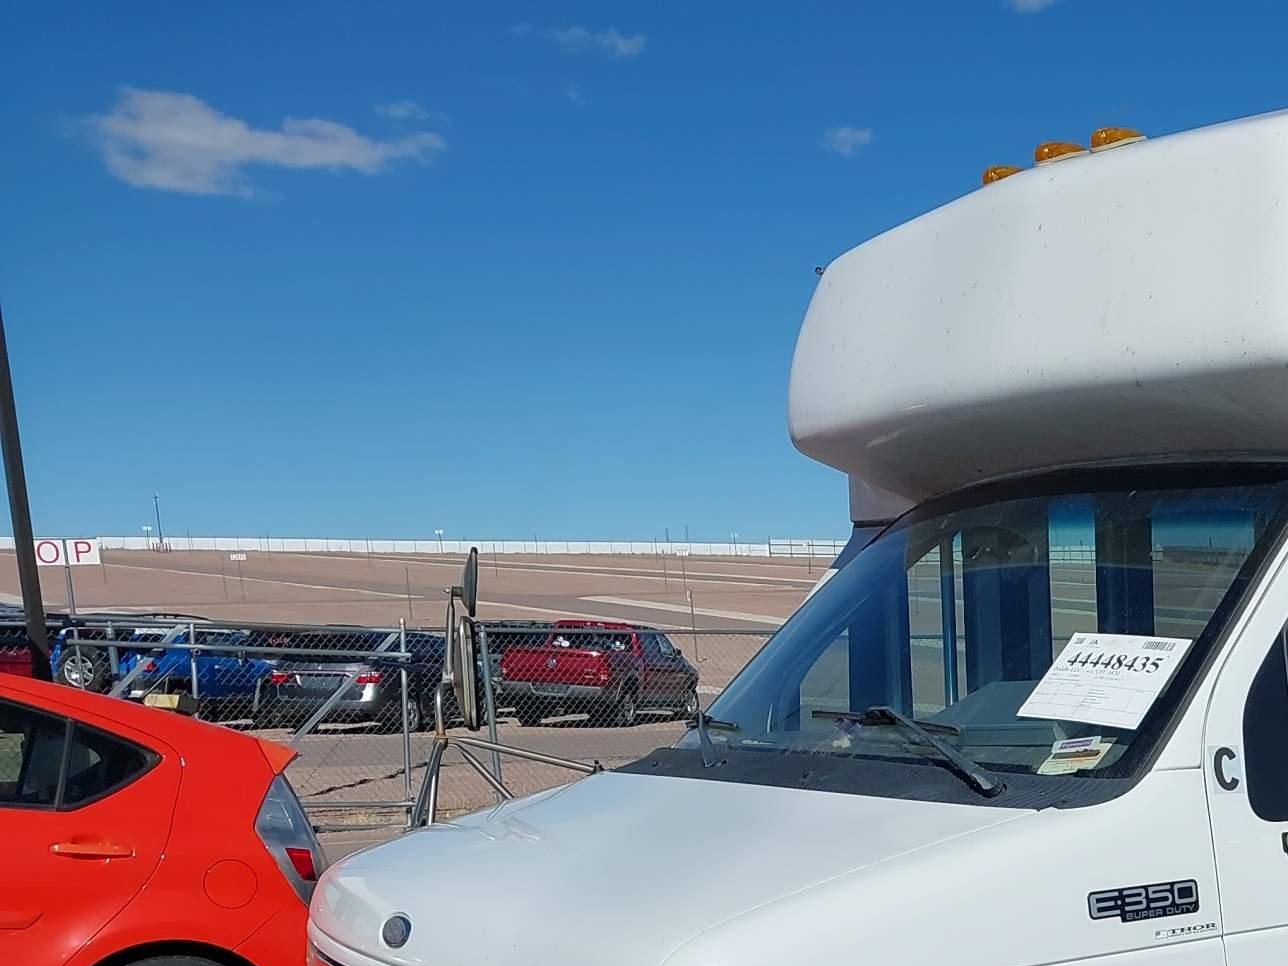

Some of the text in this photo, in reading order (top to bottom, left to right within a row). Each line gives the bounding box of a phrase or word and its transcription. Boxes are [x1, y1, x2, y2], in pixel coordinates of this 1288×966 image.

[1067, 651, 1165, 674] 44448435
[1213, 746, 1240, 792] C
[1125, 904, 1197, 921] SUPER DUTY
[1168, 922, 1218, 935] THOR
